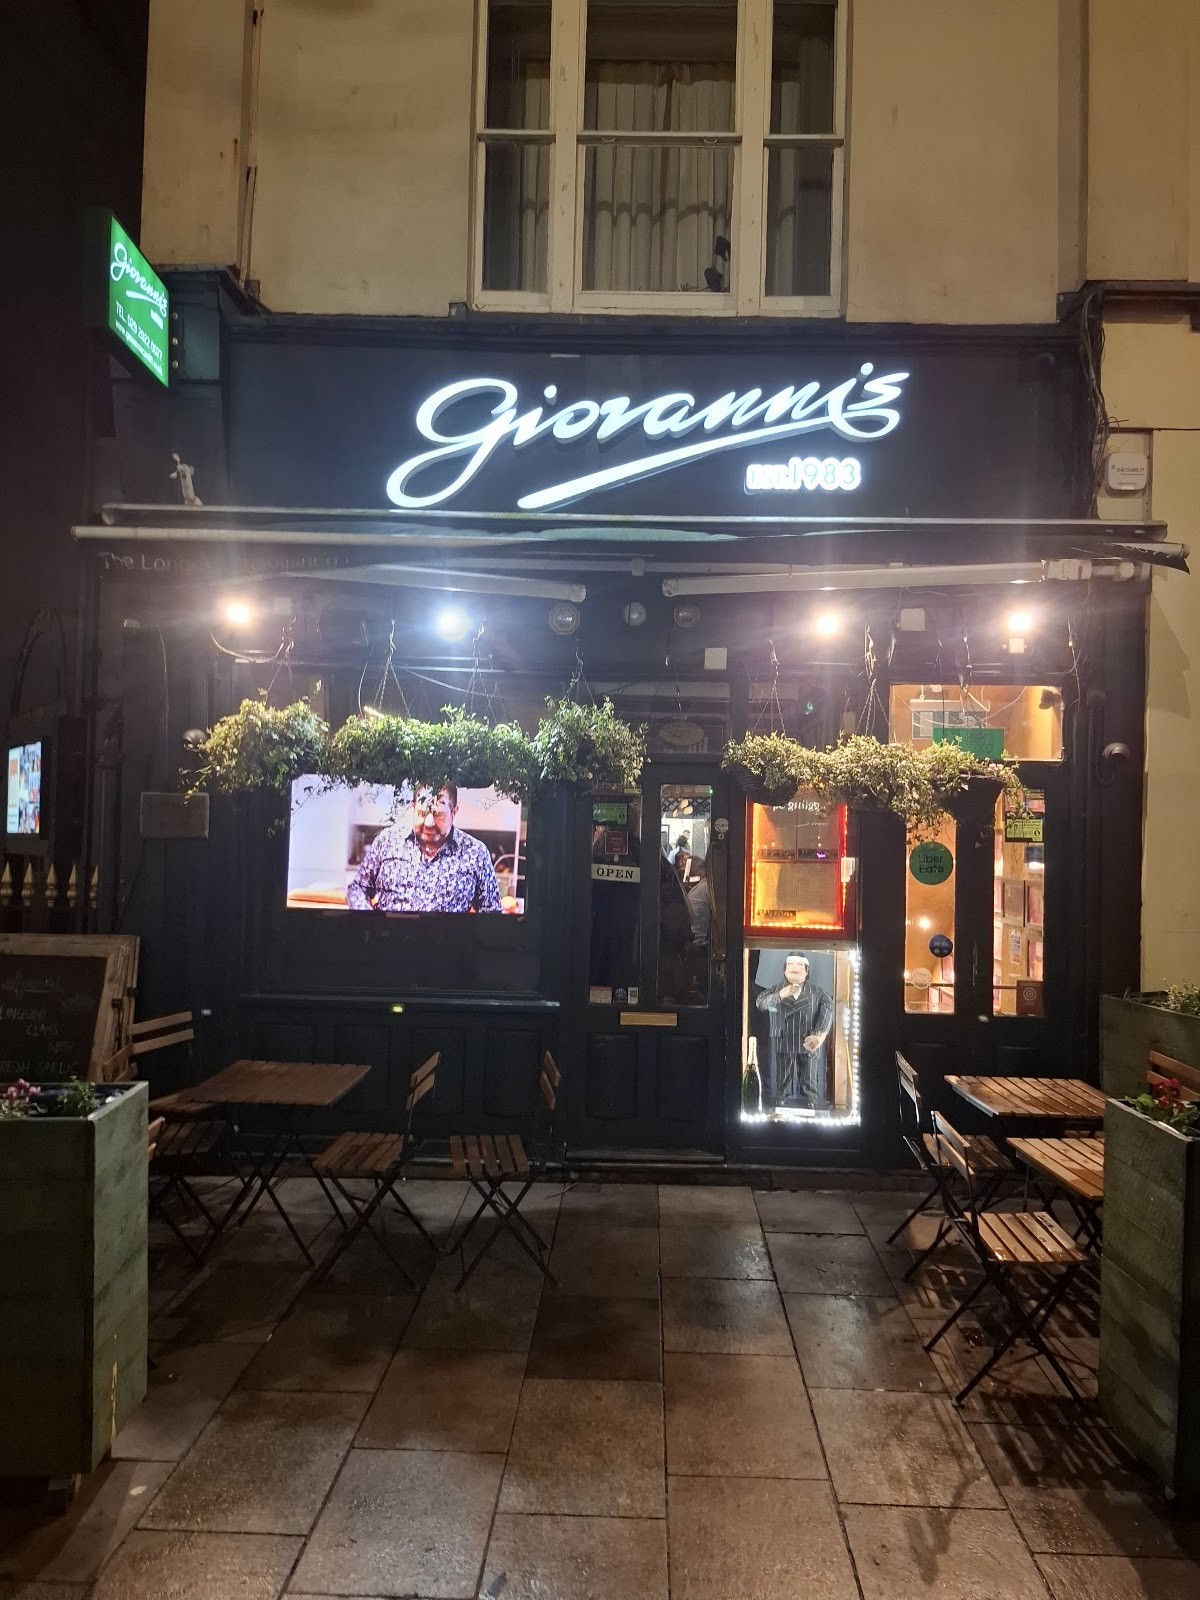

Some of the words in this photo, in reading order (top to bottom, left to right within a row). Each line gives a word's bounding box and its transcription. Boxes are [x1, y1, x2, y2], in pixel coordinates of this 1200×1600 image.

[918, 854, 943, 863] Uber
[596, 867, 635, 879] OPEN
[918, 864, 945, 874] Eats
